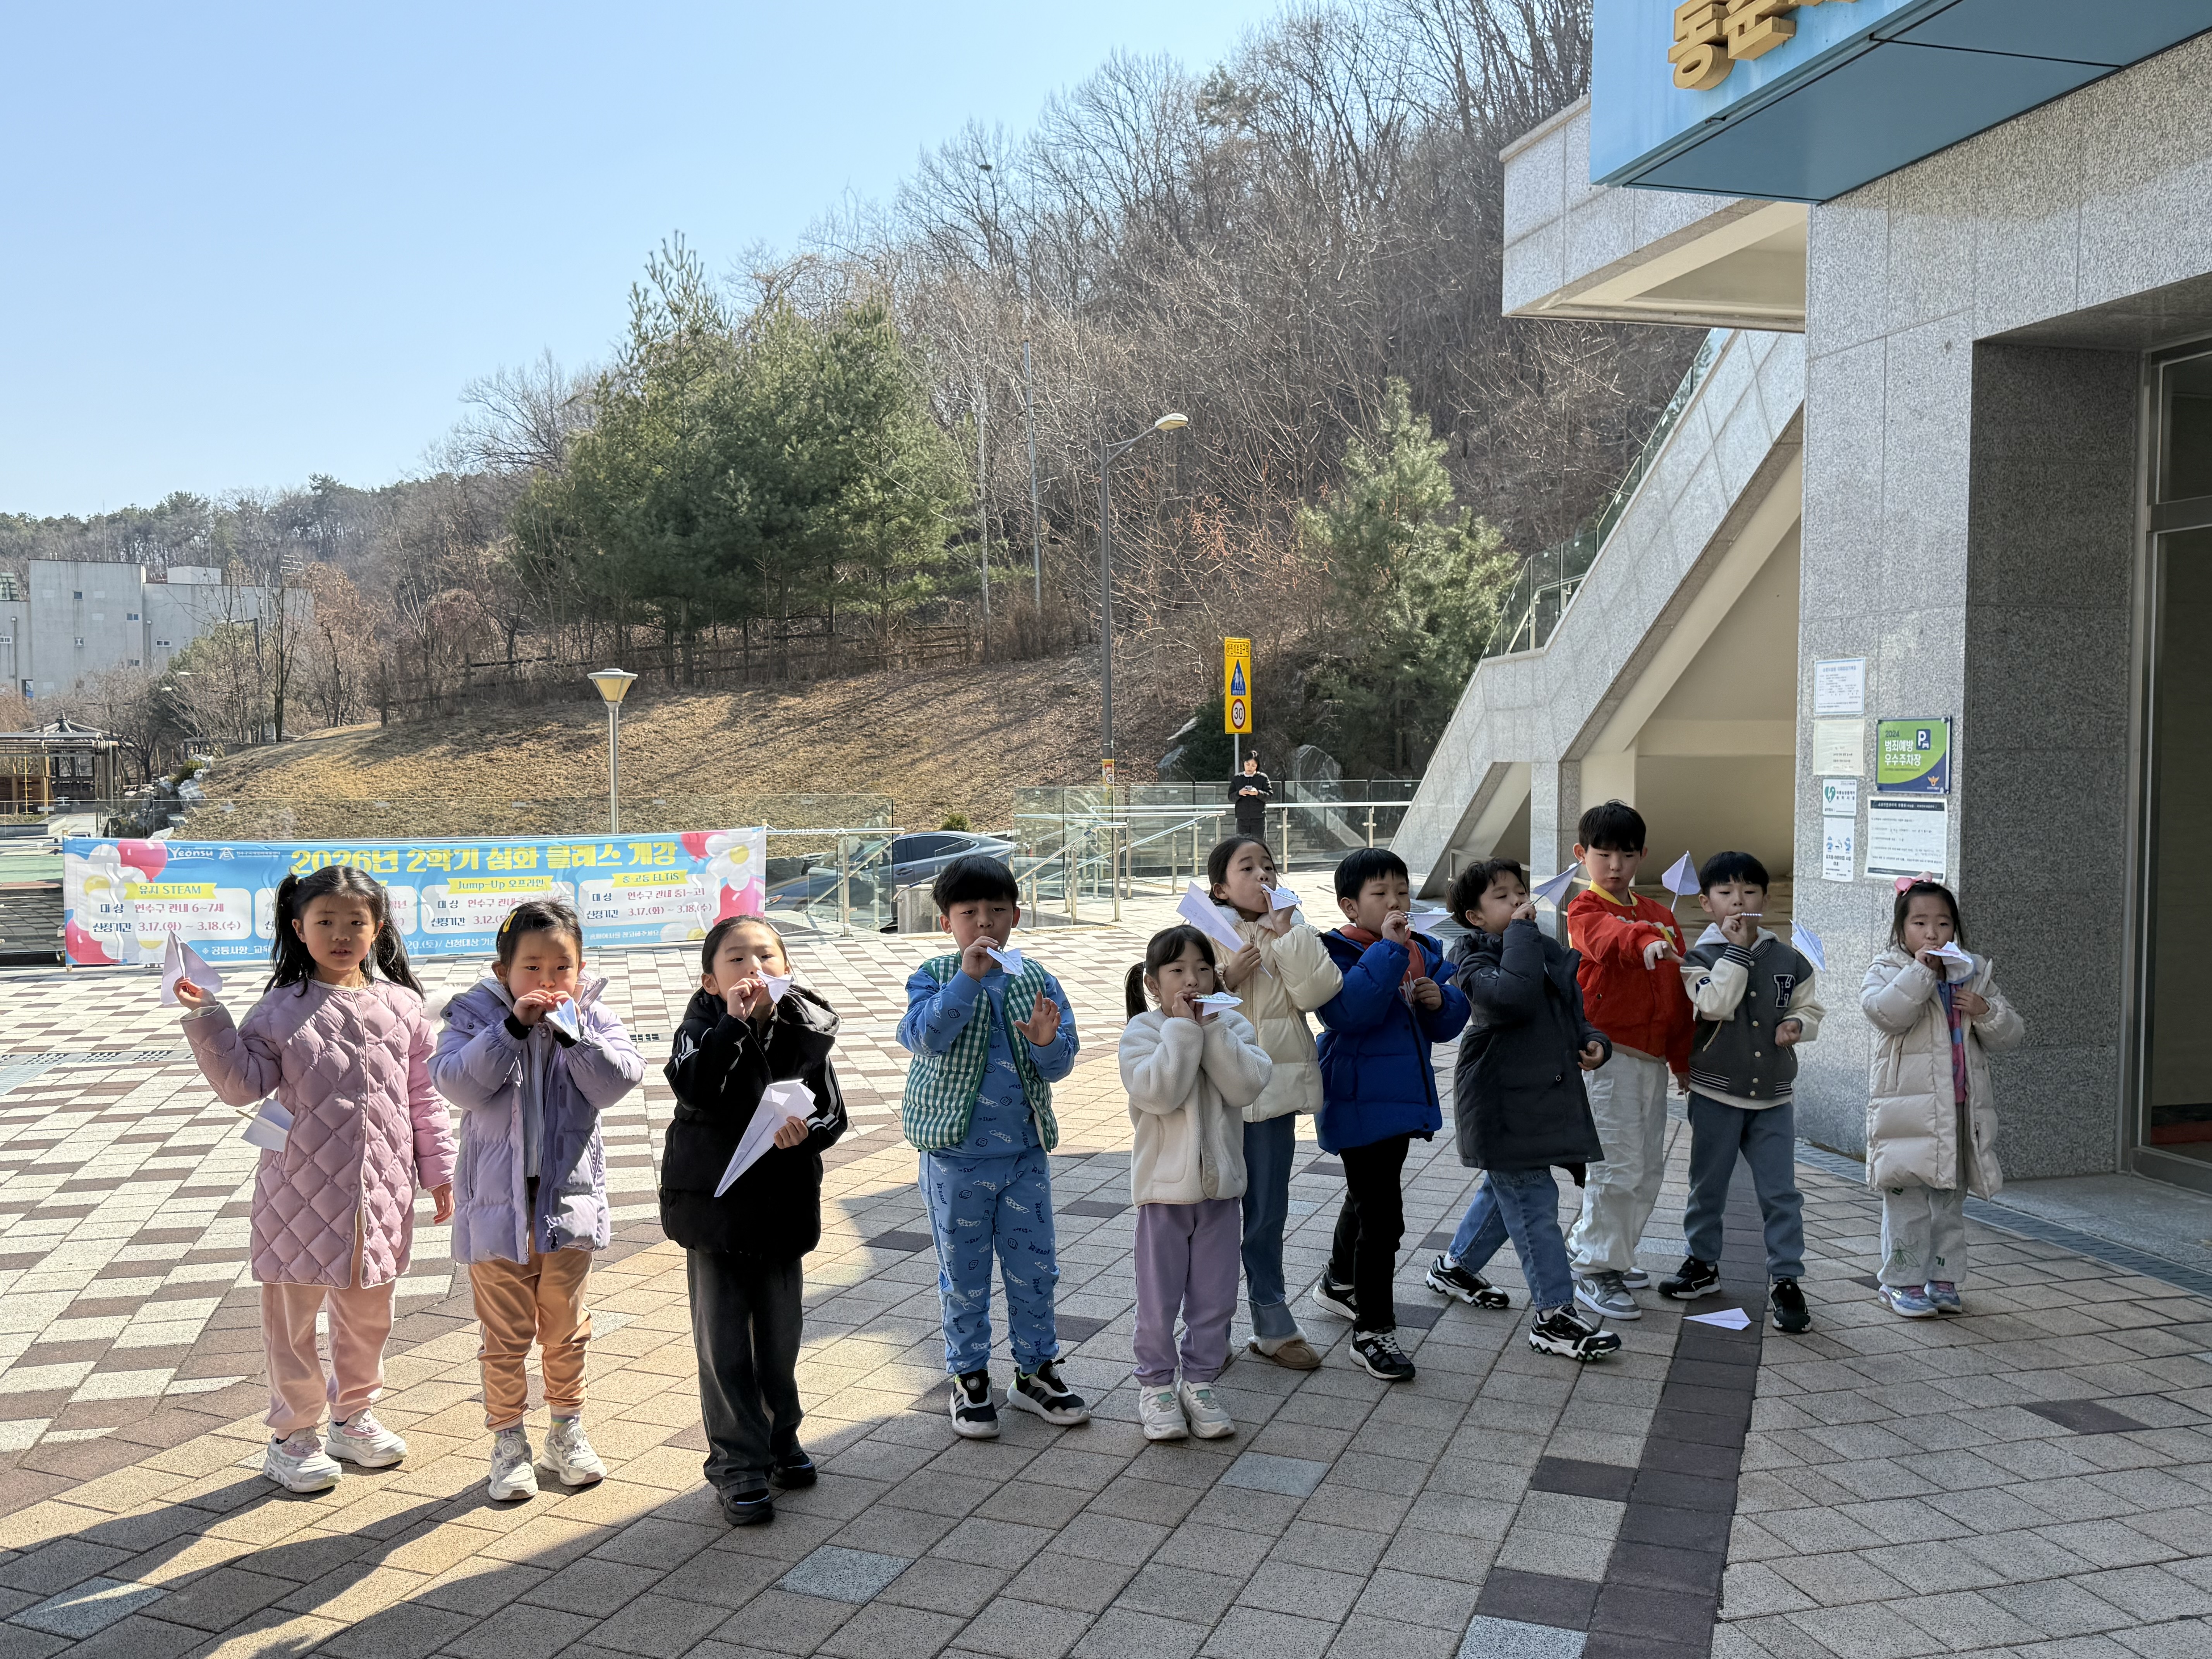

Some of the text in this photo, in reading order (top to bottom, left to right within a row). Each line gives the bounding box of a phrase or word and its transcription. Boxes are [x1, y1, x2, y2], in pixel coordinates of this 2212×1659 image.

[1668, 0, 1858, 90] 동춘
[1234, 707, 1243, 720] 30
[1884, 740, 1913, 752] 범죄예방
[1884, 754, 1921, 766] 우수주차장
[168, 847, 213, 859] Yeonsu
[292, 850, 399, 874] 2026년
[407, 847, 479, 872] 2학기
[486, 846, 540, 871] 심화
[628, 842, 678, 866] 개강
[163, 885, 201, 894] STEAM
[458, 878, 544, 890] Jump-Up 오프라인
[627, 891, 653, 900] 연수구
[656, 890, 672, 898] 관내
[135, 903, 225, 913] 연수구 관내 6~7세
[468, 898, 495, 908] 연수구
[628, 906, 664, 916] 3.17.(화)
[677, 903, 712, 914] 3.18.(수)
[138, 921, 182, 932] 3.17.(화)
[198, 921, 241, 931] 3.18.(수)
[445, 938, 479, 948] 신청대상
